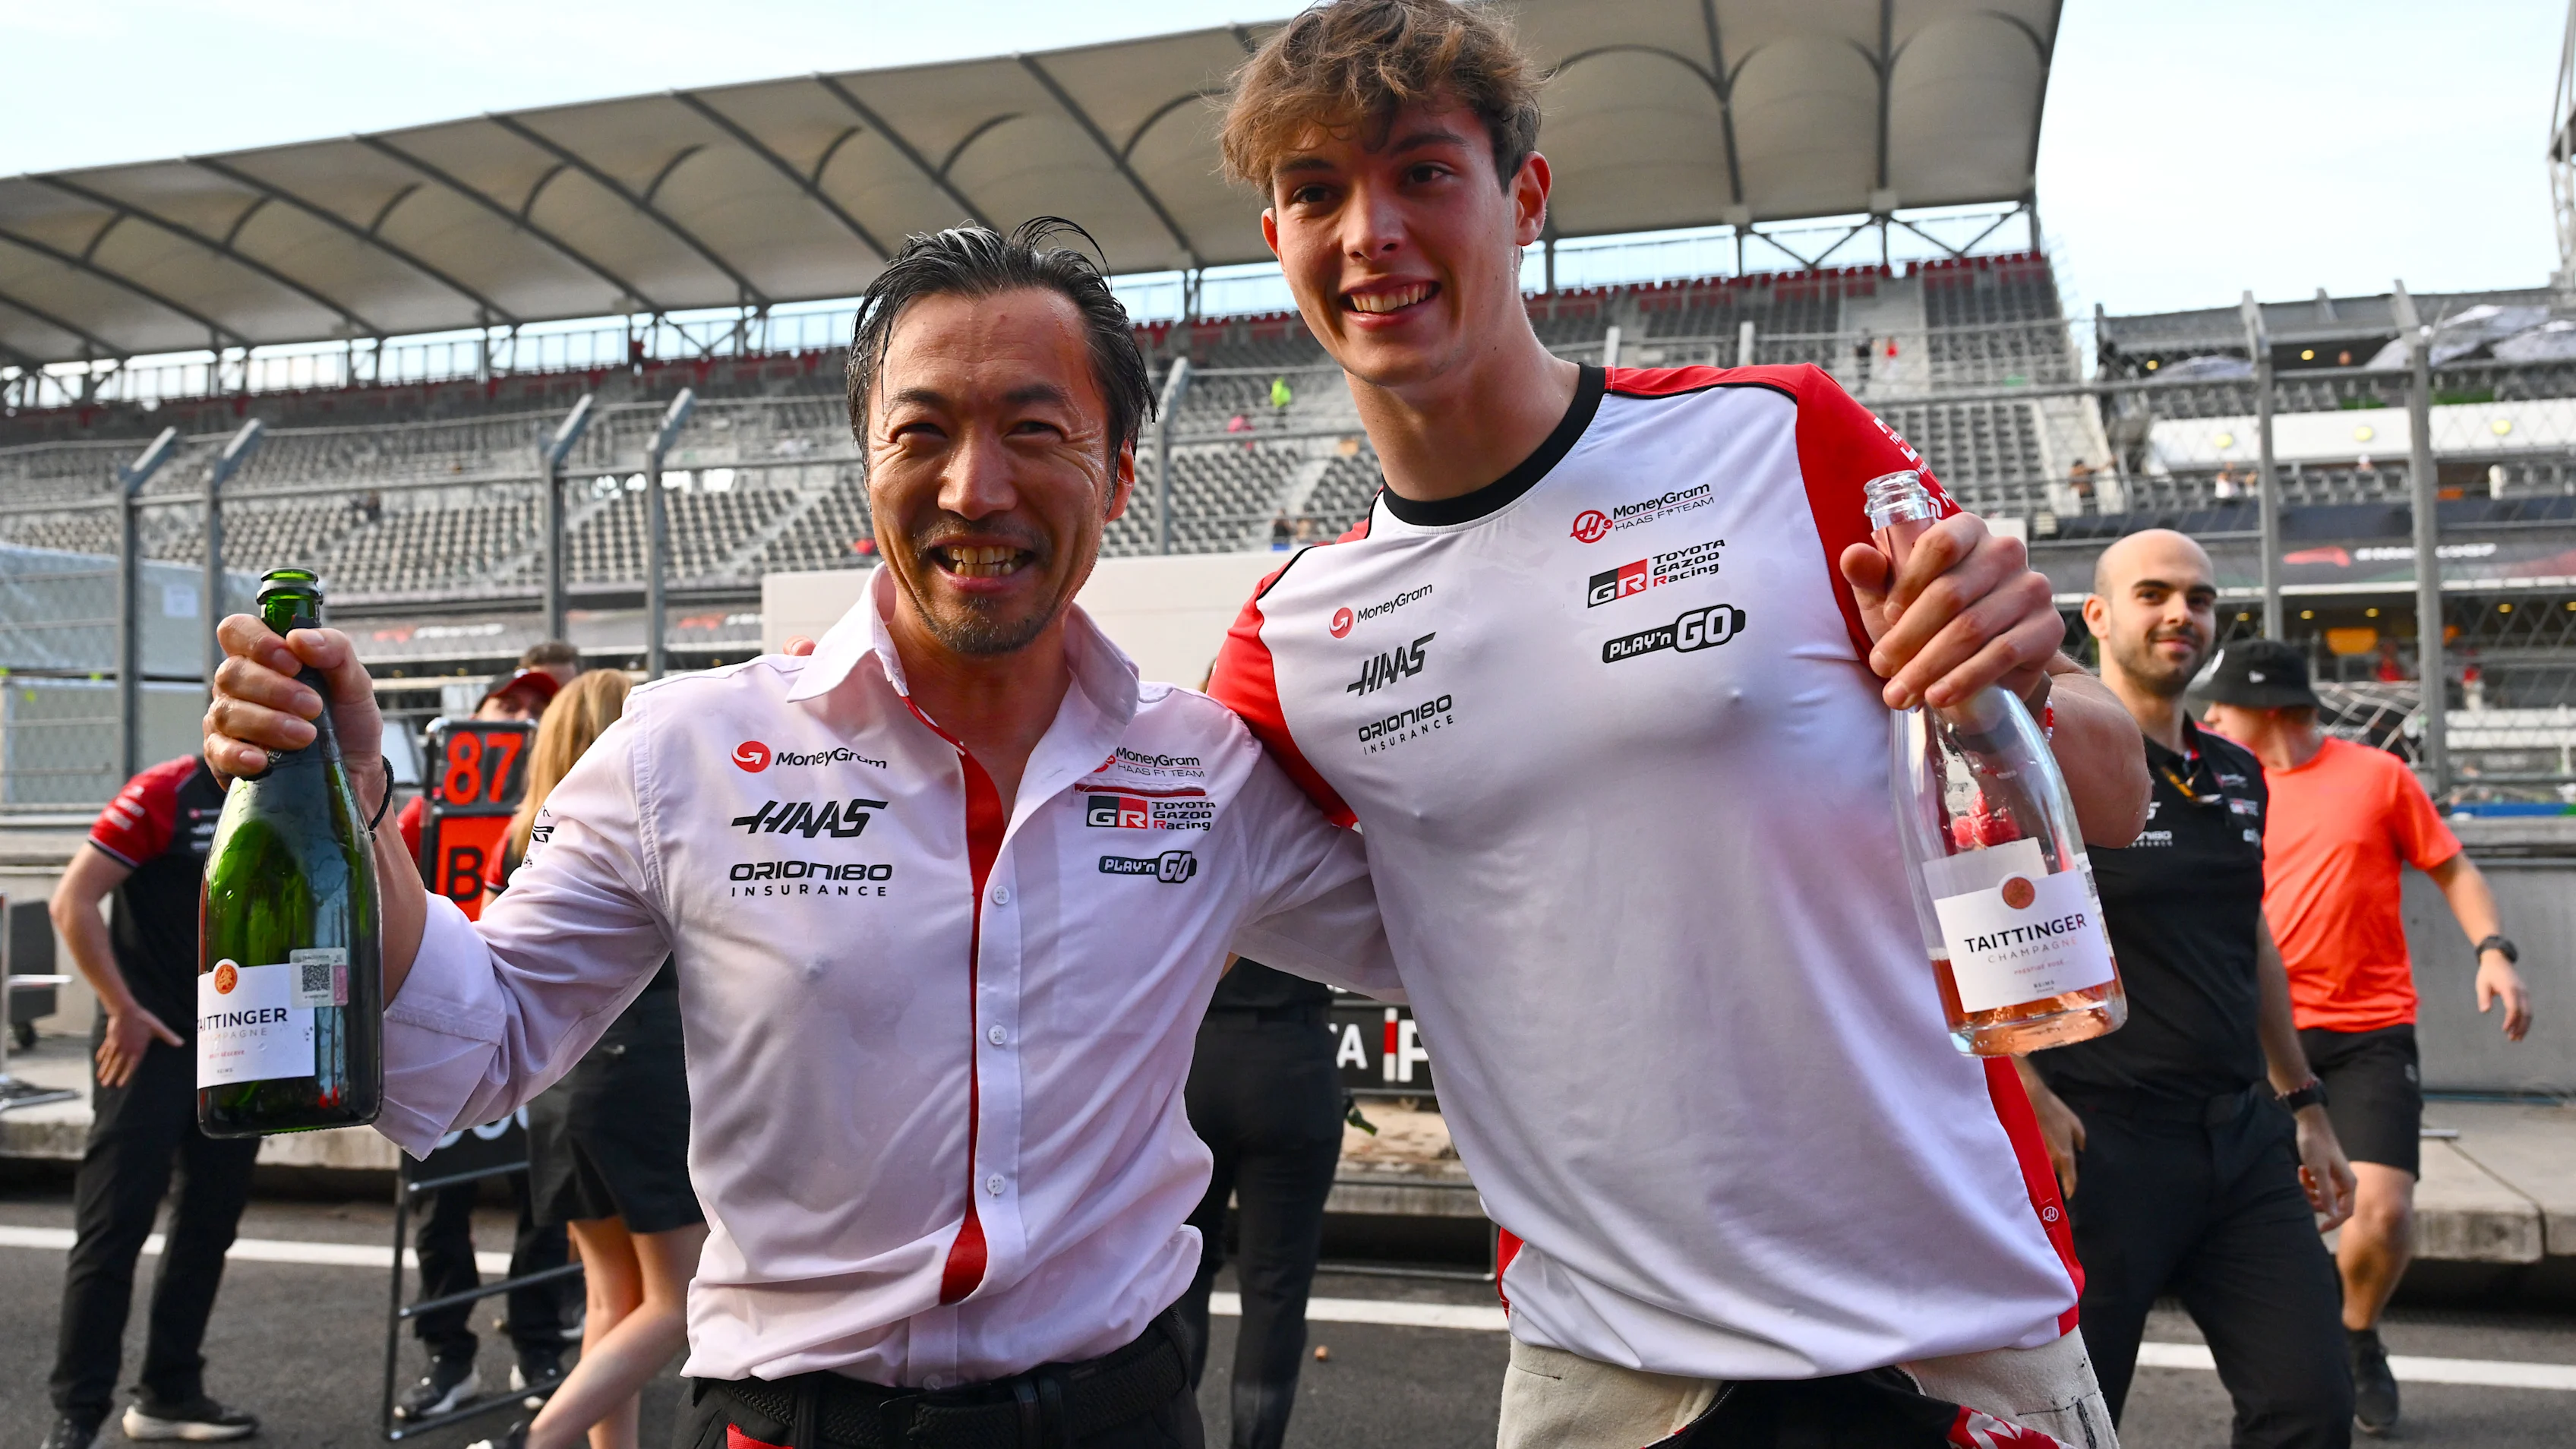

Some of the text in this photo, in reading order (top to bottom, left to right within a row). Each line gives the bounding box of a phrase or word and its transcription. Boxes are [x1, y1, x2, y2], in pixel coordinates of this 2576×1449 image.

[1613, 484, 1710, 519] MoneyGram
[1615, 515, 1653, 532] HAAS
[1674, 496, 1715, 514] TEAM
[1653, 539, 1725, 565] TOYOTA
[1653, 551, 1719, 576] GAZOO
[1589, 572, 1646, 606] GR
[1653, 563, 1719, 587] Racing
[1357, 584, 1433, 623] MoneyGram
[1675, 605, 1733, 651] GO
[1346, 631, 1437, 696] HAAS
[1363, 715, 1454, 756] INSURANCE
[443, 731, 523, 806] 87
[775, 747, 888, 769] MoneyGram
[1116, 747, 1201, 768] MoneyGram
[1117, 762, 1205, 778] HAAS F1 TEAM
[731, 799, 889, 838] HAAS
[1088, 807, 1147, 828] GR
[1151, 801, 1217, 810] TOYOTA
[1152, 810, 1213, 819] GAZOO
[1153, 819, 1211, 832] Racing
[1158, 851, 1192, 882] GO
[731, 884, 887, 898] INSURANCE
[1964, 913, 2088, 953] TAITTINGER
[1987, 936, 2078, 964] CHAMPAGNE
